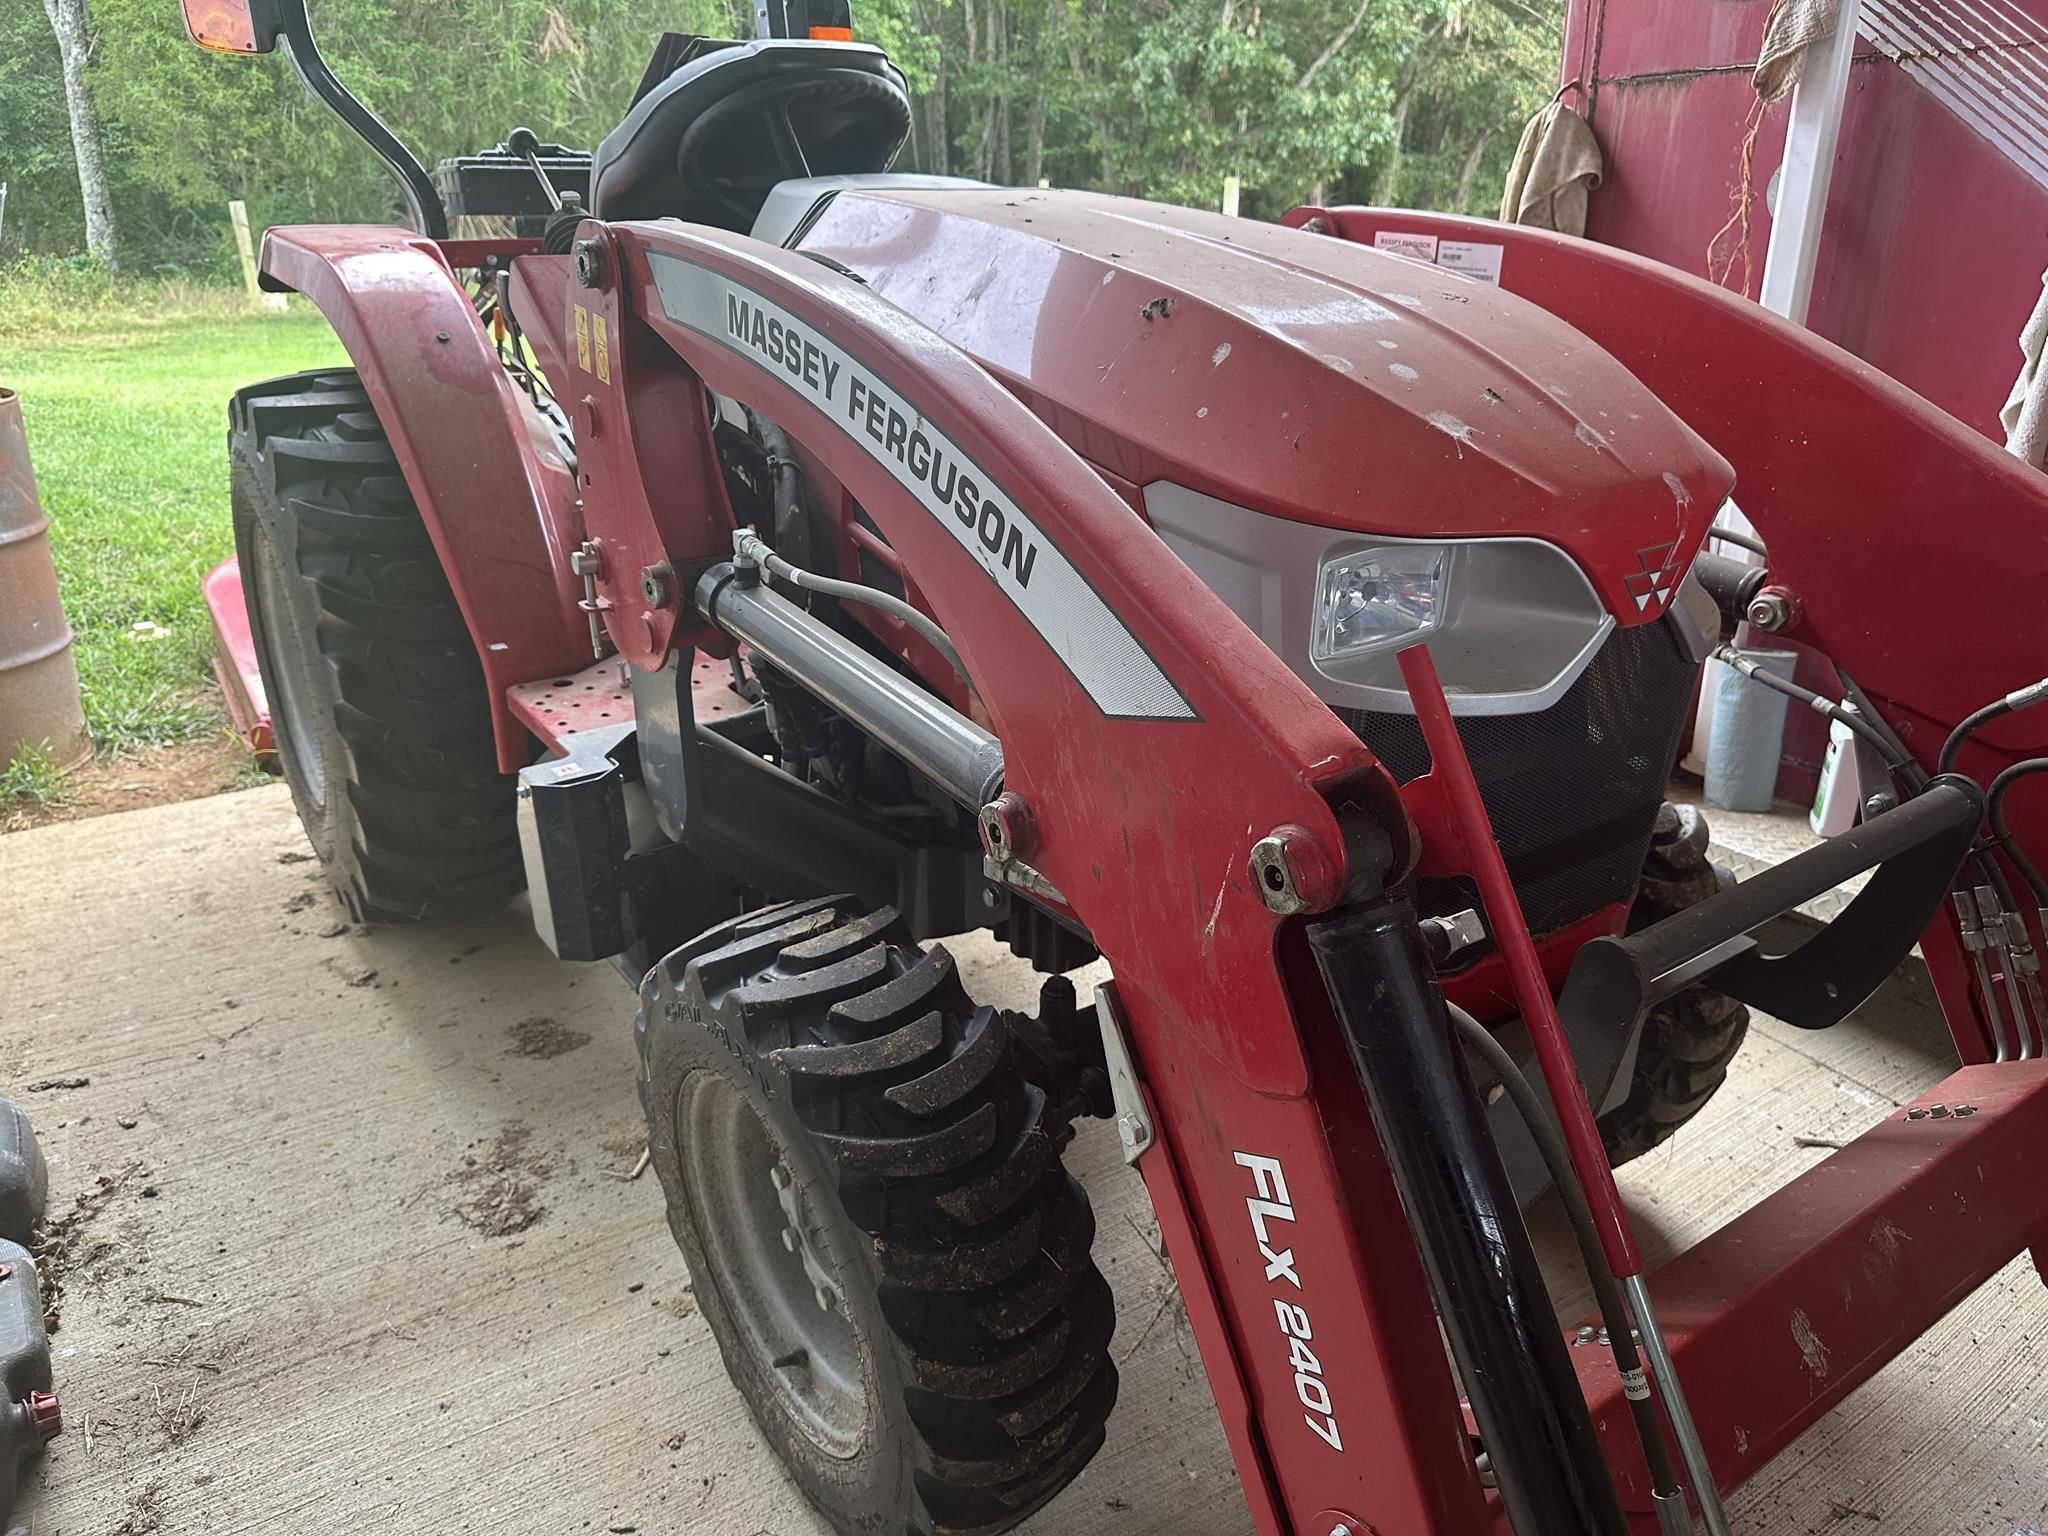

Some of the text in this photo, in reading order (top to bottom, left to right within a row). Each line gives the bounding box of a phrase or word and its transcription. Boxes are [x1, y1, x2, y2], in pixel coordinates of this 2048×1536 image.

[728, 292, 1038, 590] MASSEY FERGUSON
[1273, 1298, 1344, 1453] 2407
